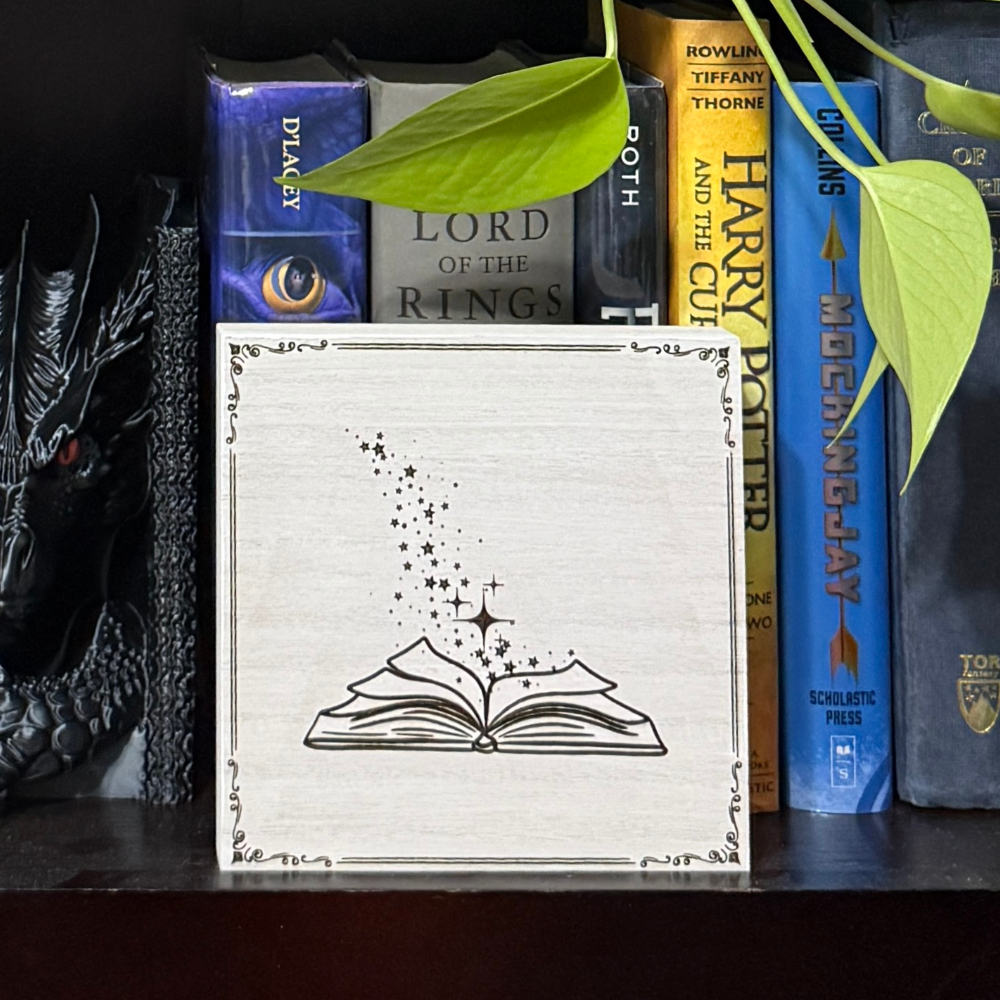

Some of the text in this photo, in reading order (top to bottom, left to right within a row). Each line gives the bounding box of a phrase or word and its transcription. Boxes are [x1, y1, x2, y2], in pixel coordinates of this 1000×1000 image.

[691, 71, 764, 84] TIFFANY
[692, 96, 765, 110] THORNE
[952, 147, 987, 166] OF
[694, 157, 712, 205] AND
[412, 208, 549, 243] LORD
[694, 210, 712, 251] THE
[721, 150, 768, 330] HARRY
[438, 255, 529, 274] OF THE
[397, 284, 563, 320] RINGS
[820, 294, 860, 603] MOCKINGJAY
[959, 654, 1000, 670] TOR
[810, 690, 877, 707] SCHOLASTIC
[826, 710, 862, 726] PRESS
